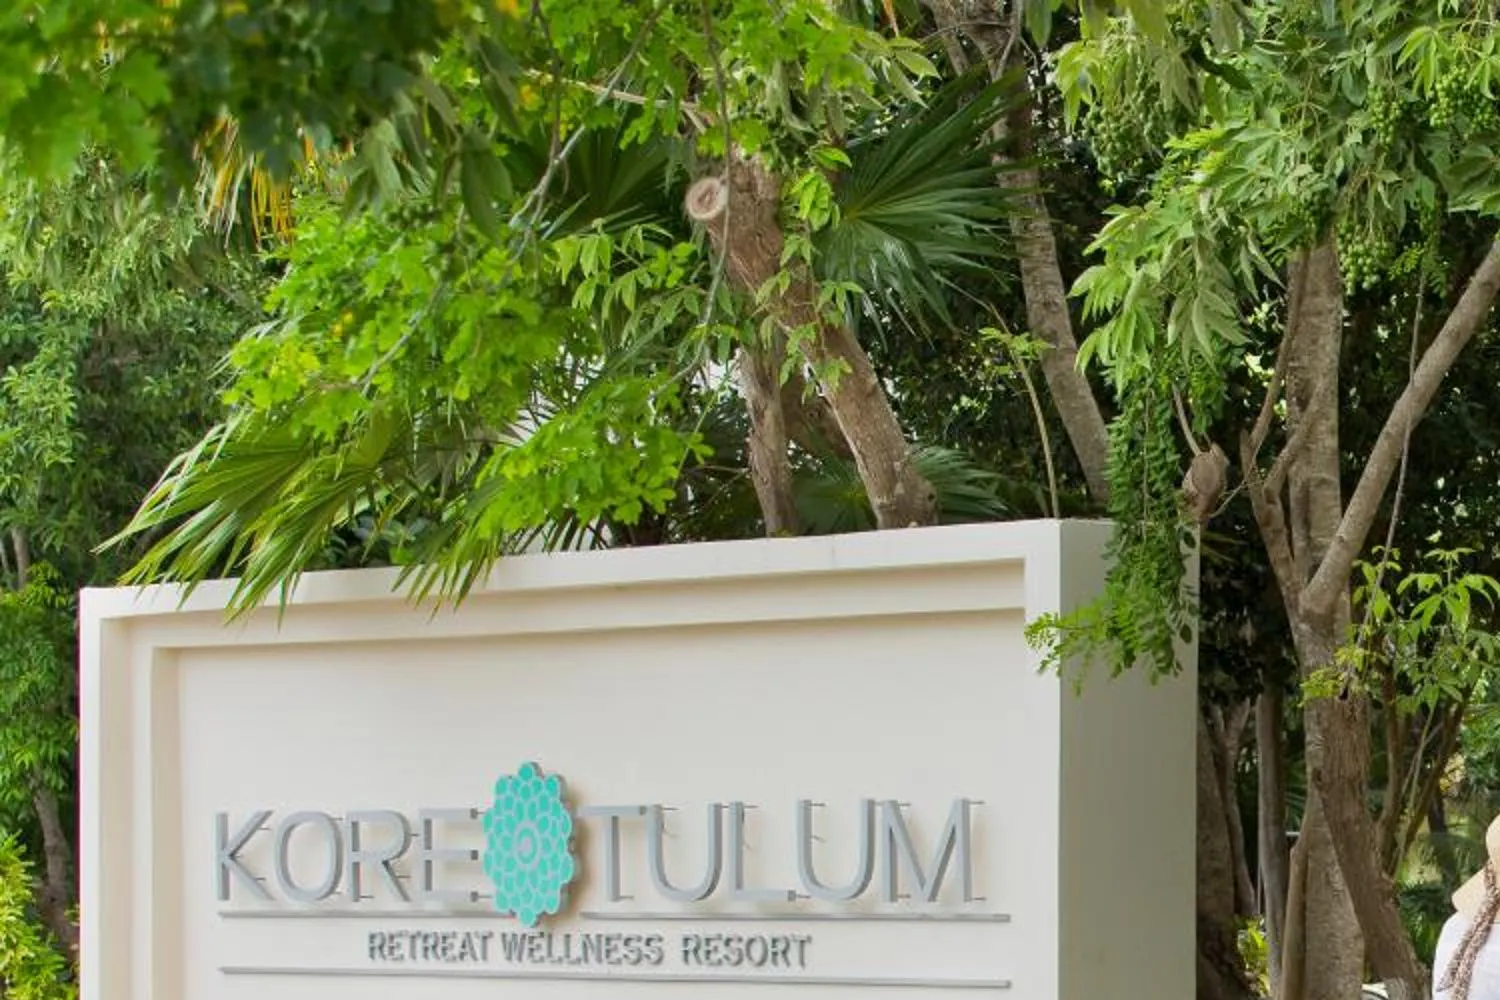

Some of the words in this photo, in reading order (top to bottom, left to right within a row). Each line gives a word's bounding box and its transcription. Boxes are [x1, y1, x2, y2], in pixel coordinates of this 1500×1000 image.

[214, 809, 480, 903] KORE
[576, 798, 974, 903] TULUM
[368, 929, 494, 963] RETREAT
[501, 931, 664, 966] WELLNESS
[681, 933, 814, 969] RESORT
